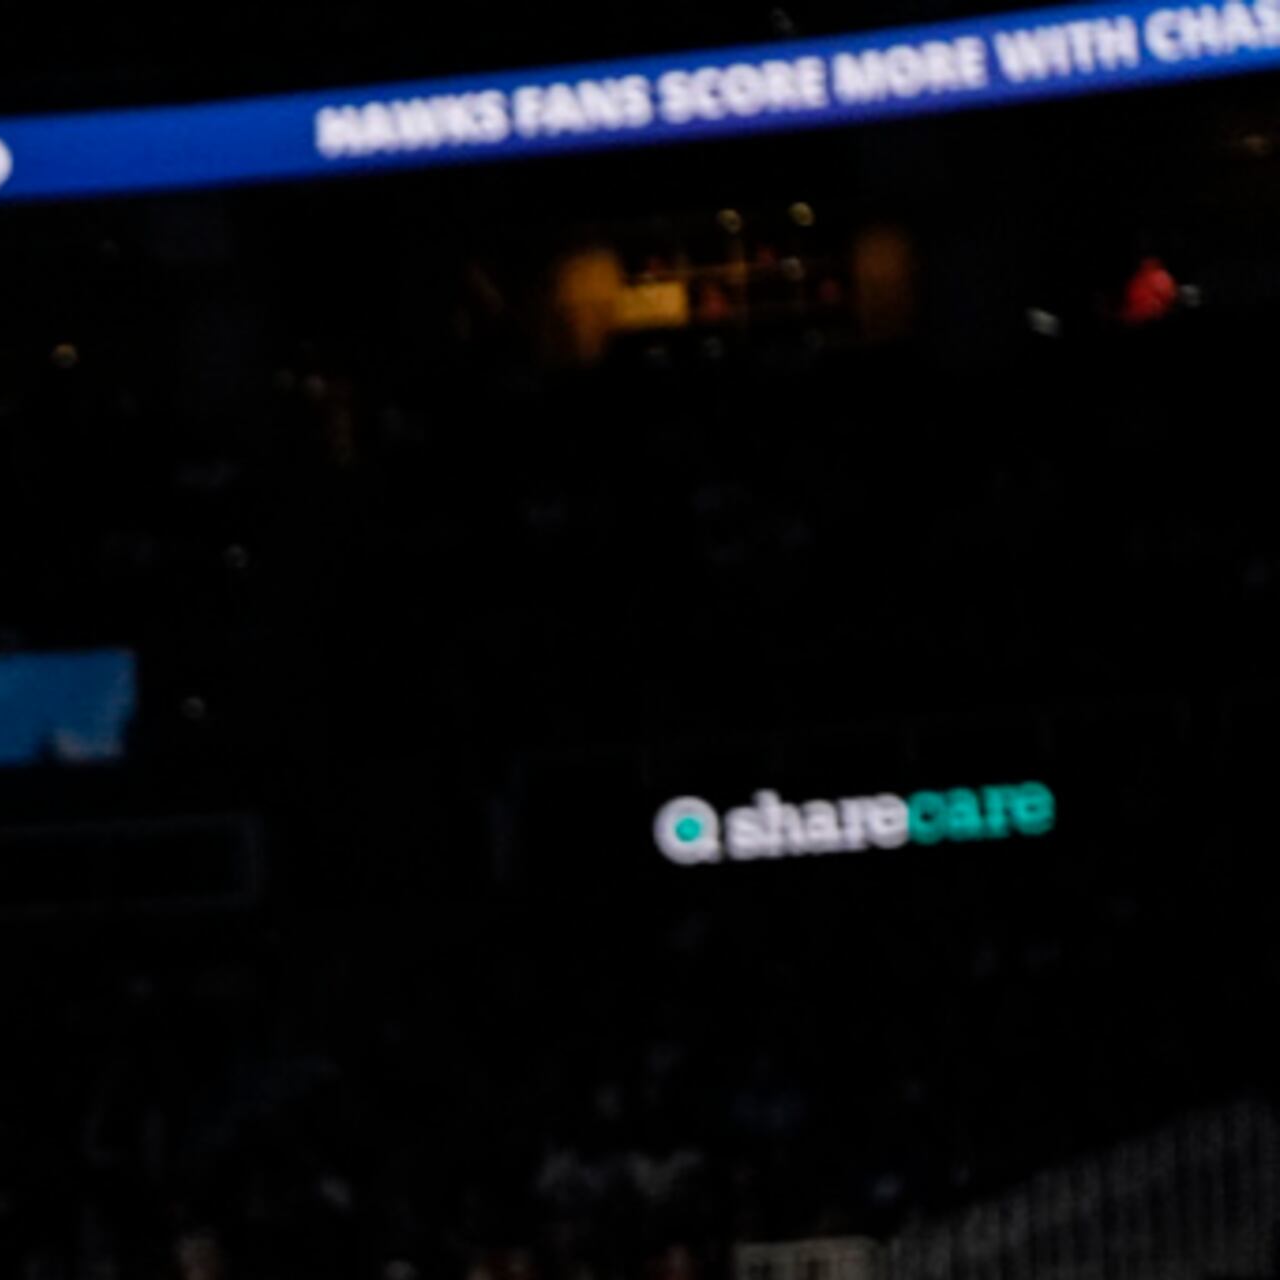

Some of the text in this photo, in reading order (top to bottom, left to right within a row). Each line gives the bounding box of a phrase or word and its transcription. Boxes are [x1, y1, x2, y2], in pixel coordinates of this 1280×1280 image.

[316, 90, 511, 156] HAWKS
[512, 75, 654, 136] FANS
[658, 56, 828, 123] SCORE
[832, 36, 987, 102] MORE
[994, 16, 1139, 82] WITH
[724, 782, 1054, 860] sharecare
